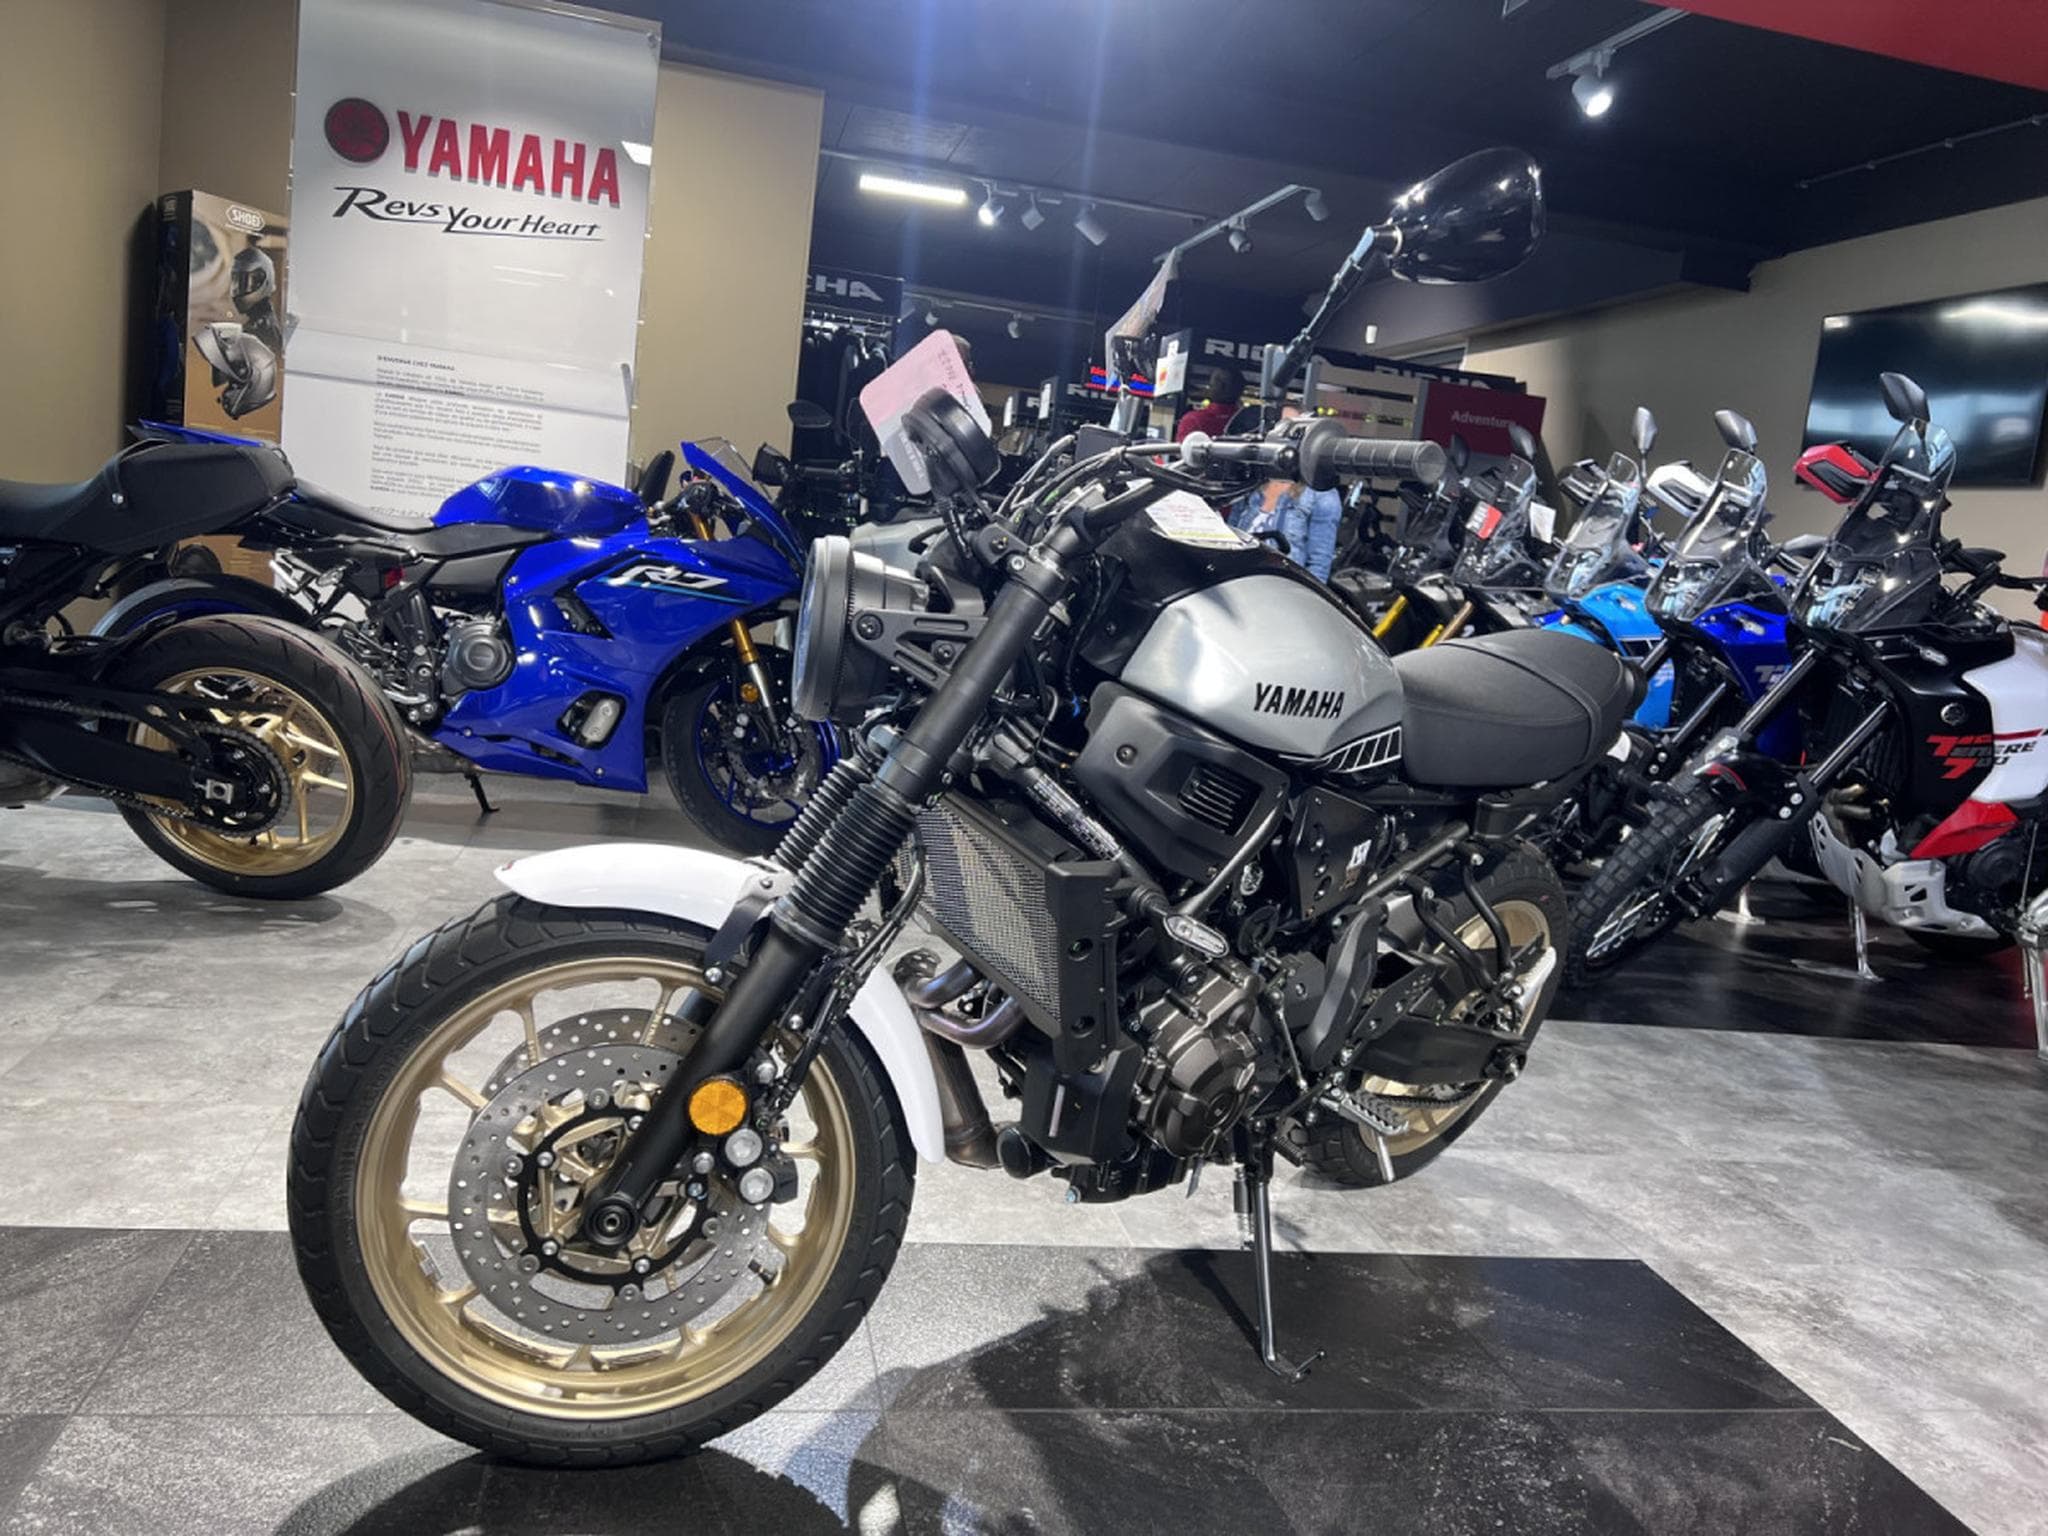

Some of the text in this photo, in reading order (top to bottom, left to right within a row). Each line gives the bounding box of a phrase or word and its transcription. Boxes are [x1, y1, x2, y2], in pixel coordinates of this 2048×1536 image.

[396, 109, 620, 208] YAMAHA
[332, 186, 602, 238] Revs Your Heart
[1253, 681, 1345, 719] YAMAHA
